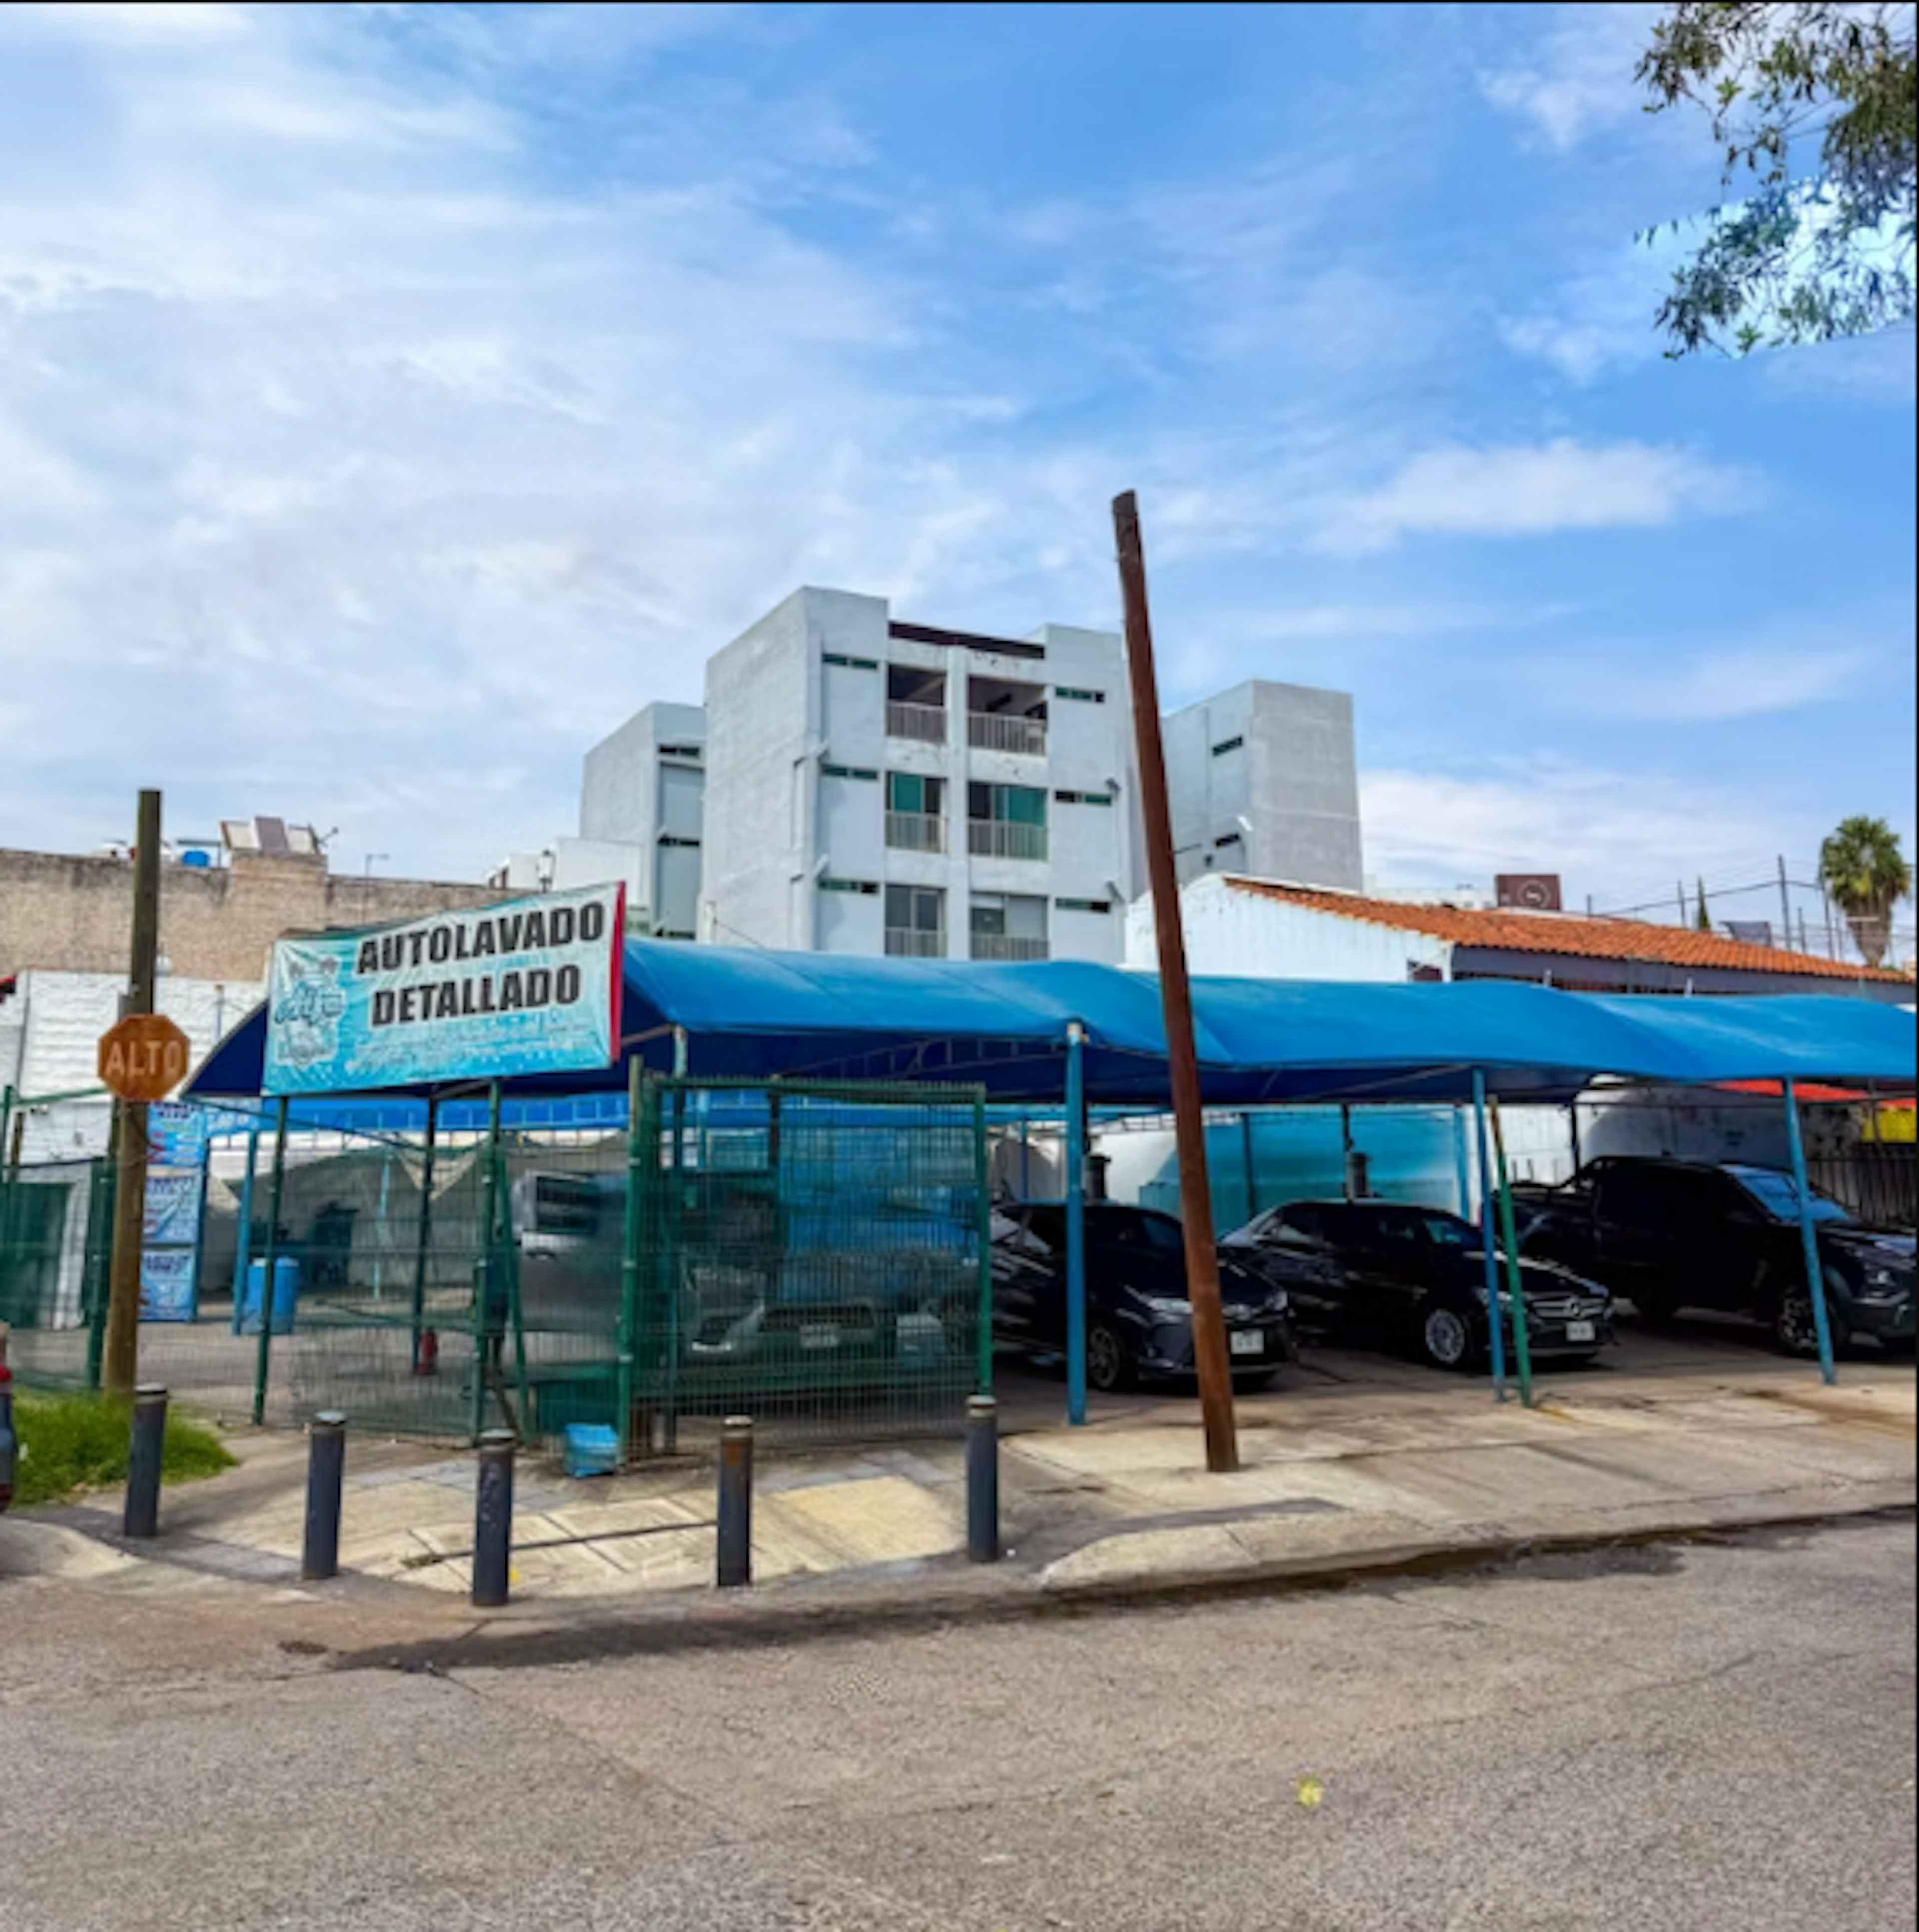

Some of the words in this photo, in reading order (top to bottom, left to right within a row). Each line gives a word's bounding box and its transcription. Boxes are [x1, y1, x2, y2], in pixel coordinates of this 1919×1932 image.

[357, 901, 605, 974] AUTOLAVADO
[372, 964, 580, 1027] DETALLADO
[104, 1040, 182, 1077] ALTO
